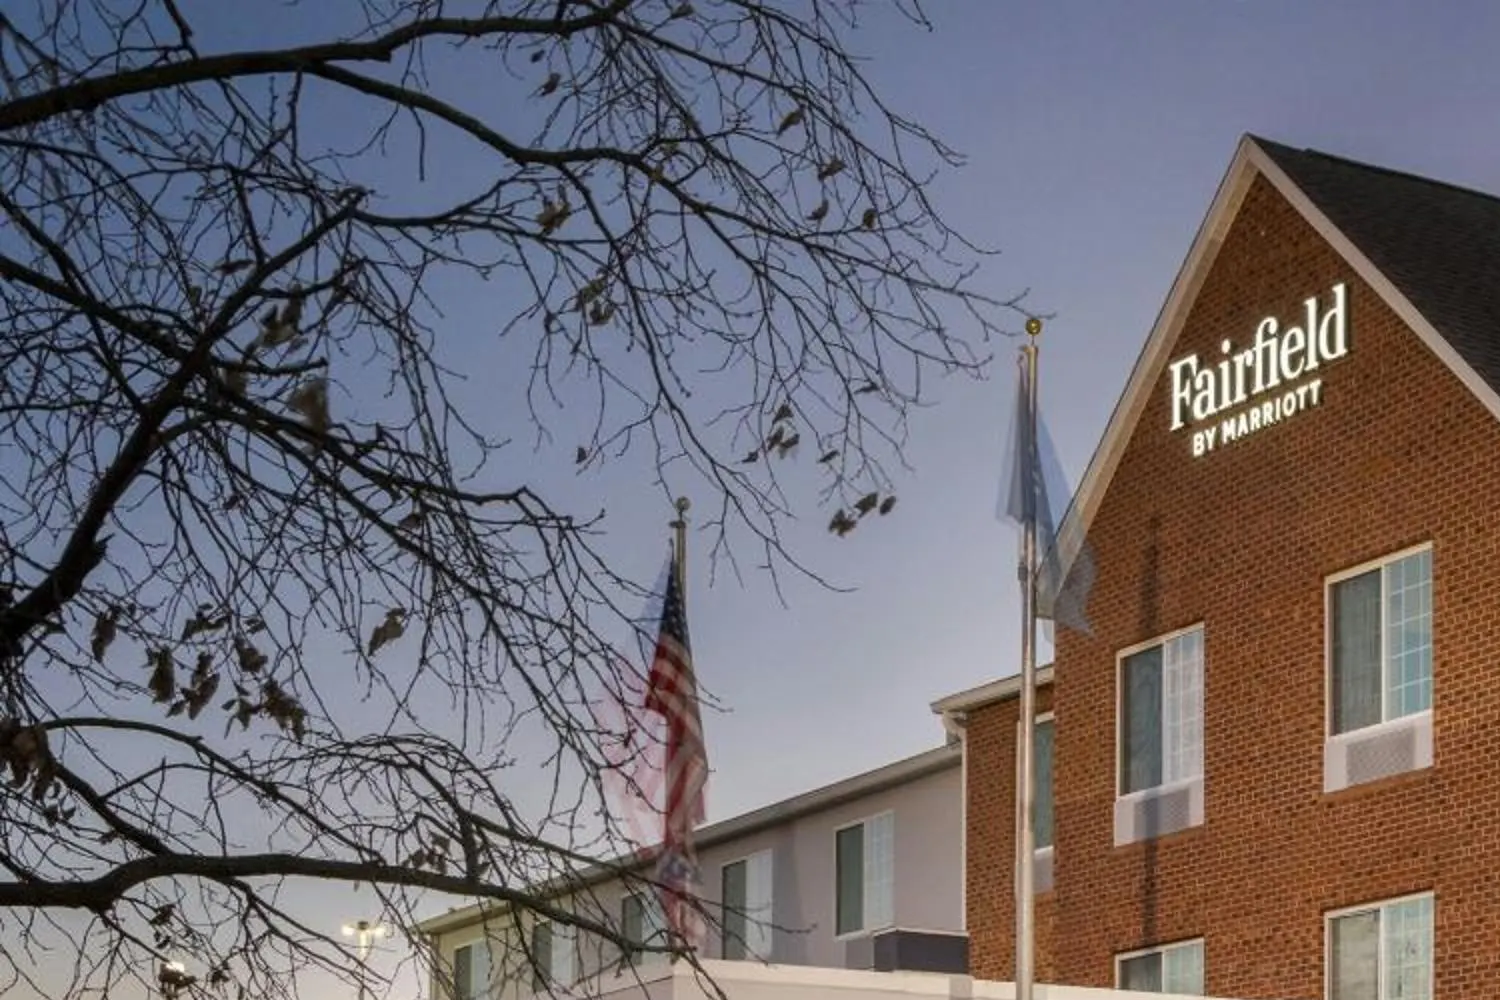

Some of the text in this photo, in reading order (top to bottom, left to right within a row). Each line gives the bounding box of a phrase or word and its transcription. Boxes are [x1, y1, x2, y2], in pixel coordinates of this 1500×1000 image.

[1170, 283, 1348, 432] Fairfield
[1193, 379, 1322, 457] BY MARRIOTT
